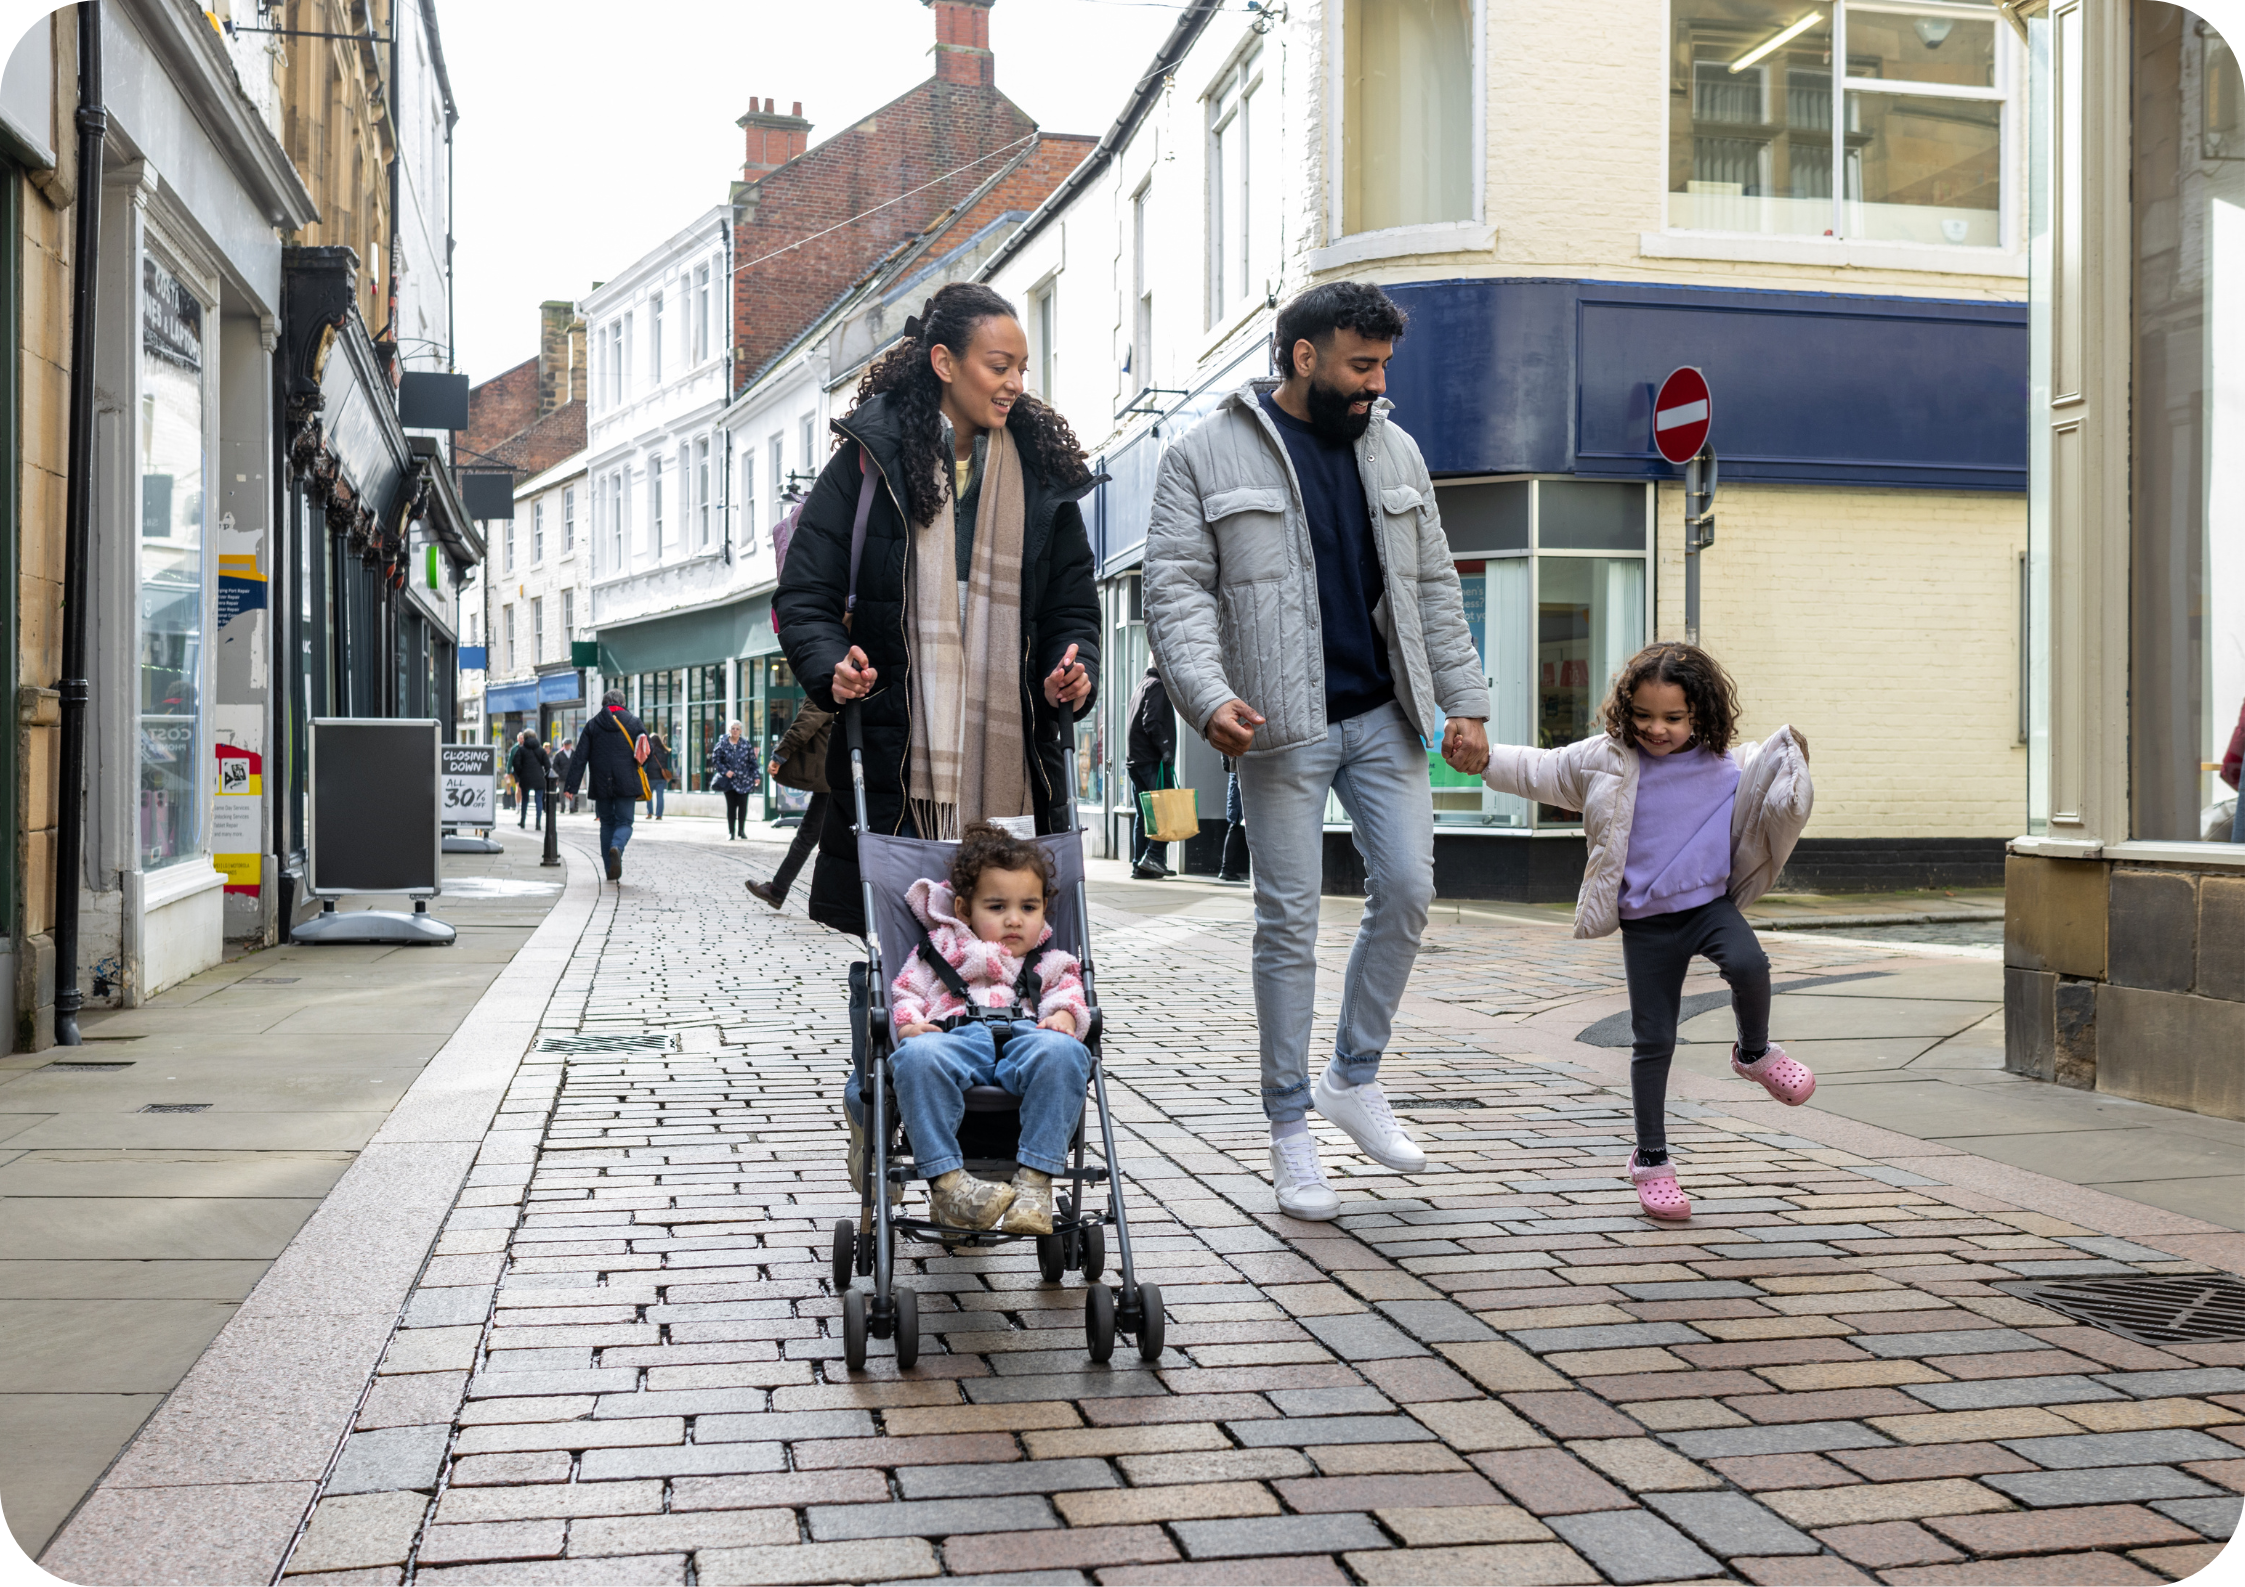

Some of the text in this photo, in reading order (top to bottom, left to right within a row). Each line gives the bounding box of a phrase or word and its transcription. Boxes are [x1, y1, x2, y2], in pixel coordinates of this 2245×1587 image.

[155, 268, 180, 314] COSTA
[170, 315, 202, 365] LAPTOPS
[443, 751, 490, 762] CLOSING
[450, 761, 482, 772] DOWN
[446, 778, 465, 787] ALL
